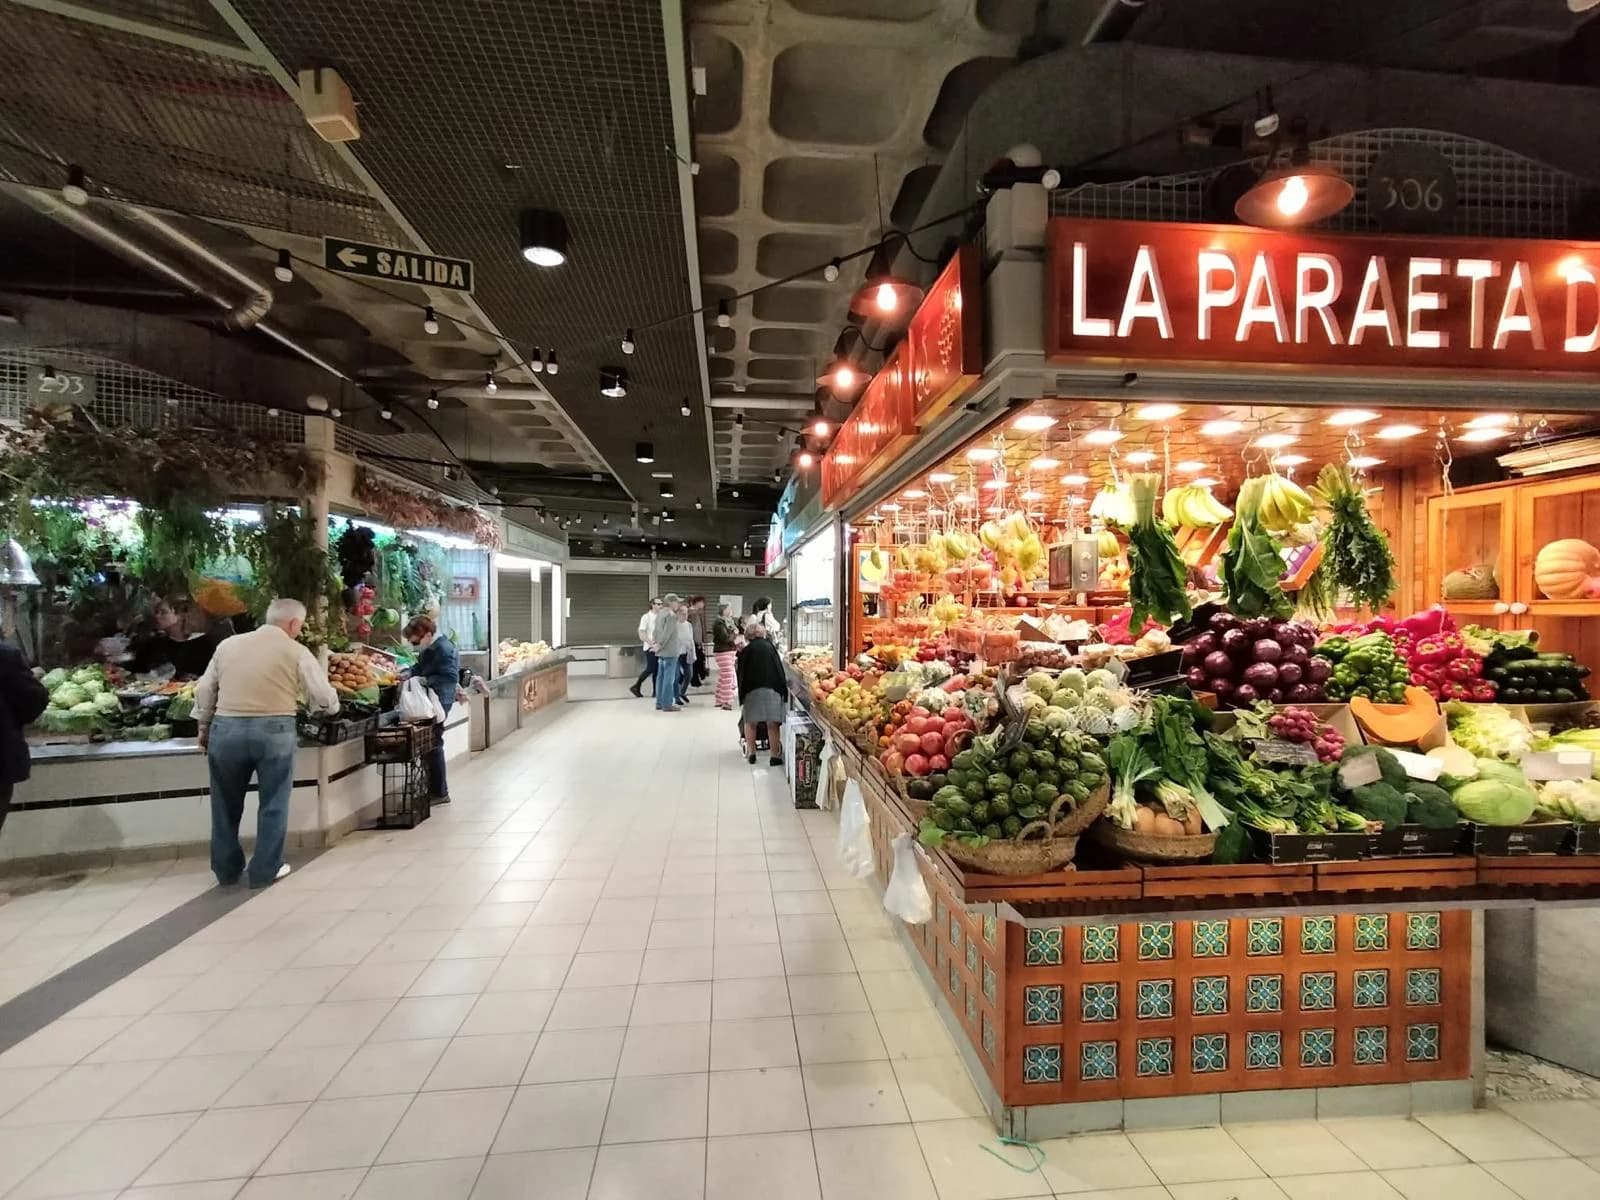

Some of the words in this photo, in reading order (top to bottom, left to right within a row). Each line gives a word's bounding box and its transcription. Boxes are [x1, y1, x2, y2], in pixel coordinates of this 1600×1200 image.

[1382, 177, 1443, 211] 306
[376, 251, 465, 287] SALIDA
[1072, 241, 1174, 339] LA
[1196, 251, 1545, 350] PARAETA
[675, 562, 750, 574] PARAFARMACIA
